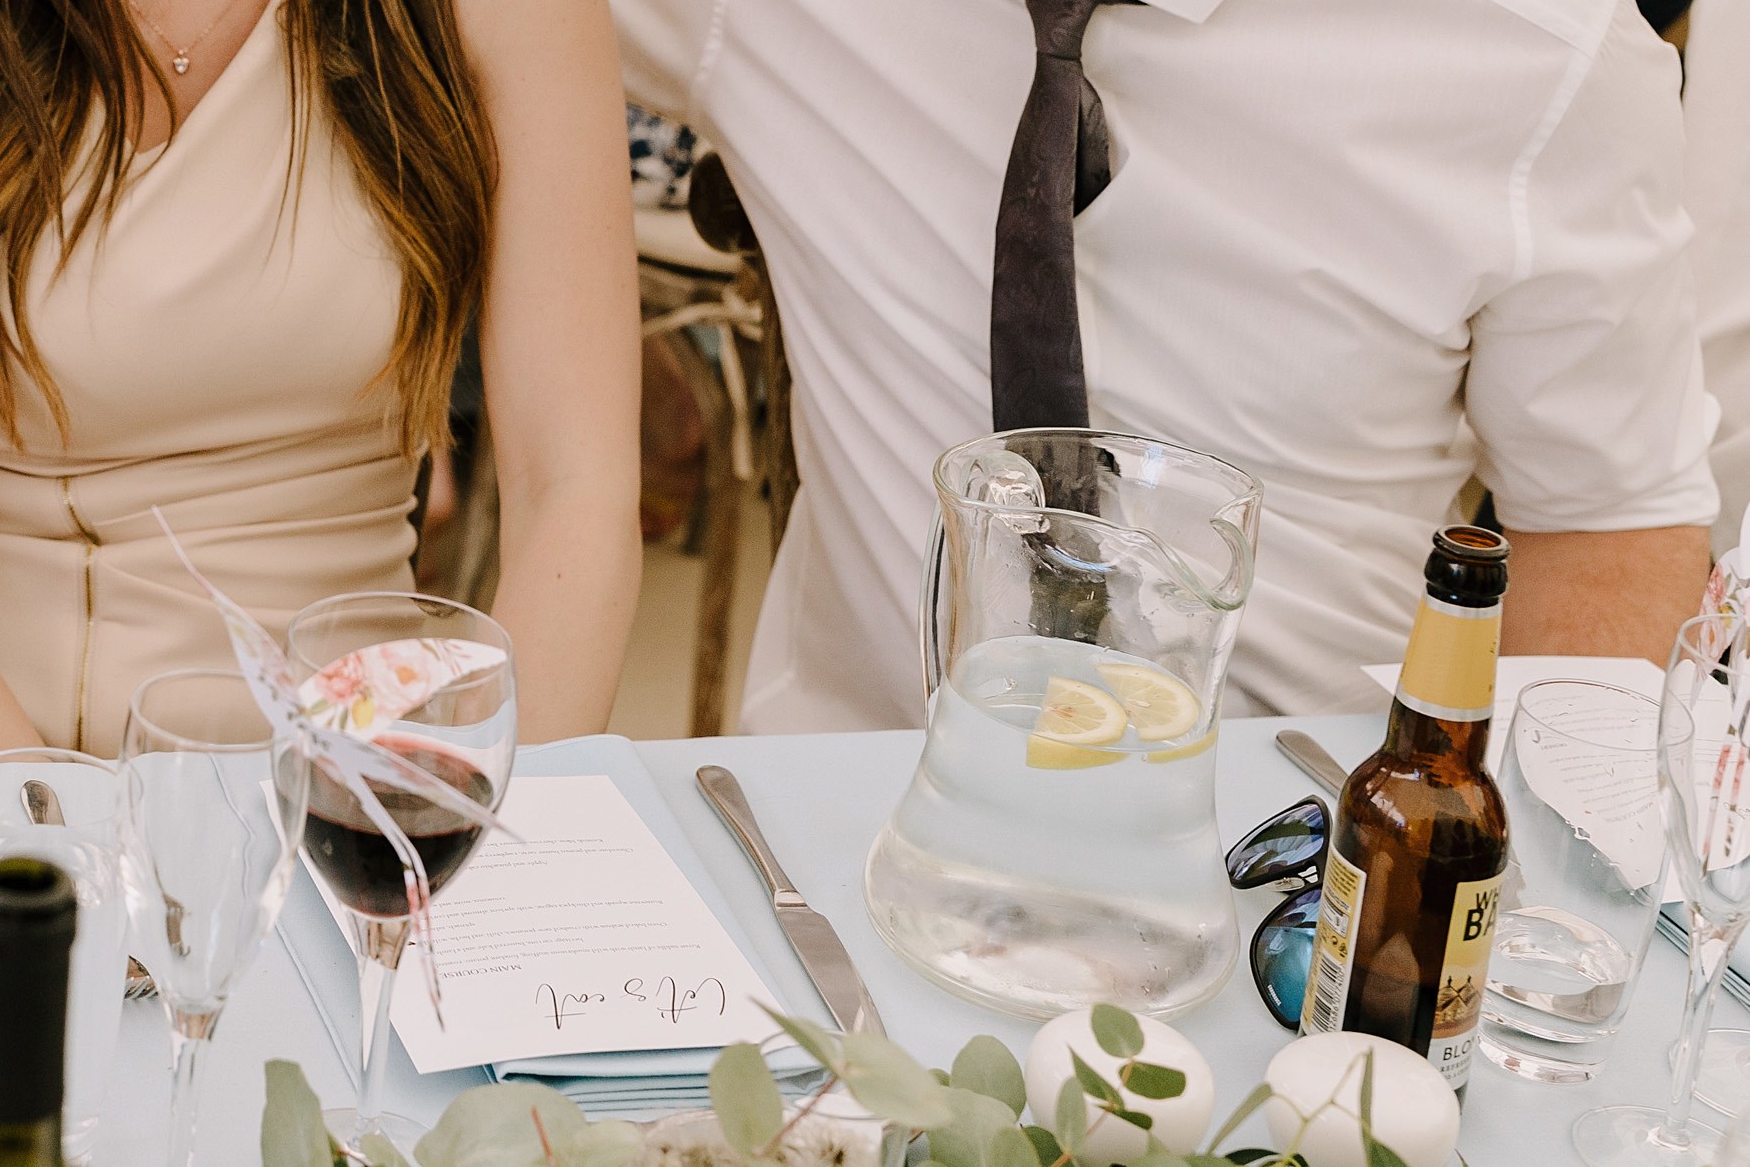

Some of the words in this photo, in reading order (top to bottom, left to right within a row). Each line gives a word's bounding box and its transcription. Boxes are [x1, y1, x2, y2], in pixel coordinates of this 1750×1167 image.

[439, 968, 487, 979] COURSE
[535, 983, 605, 1031] eat
[619, 976, 725, 1025] Let's
[1442, 1036, 1475, 1061] BLO
